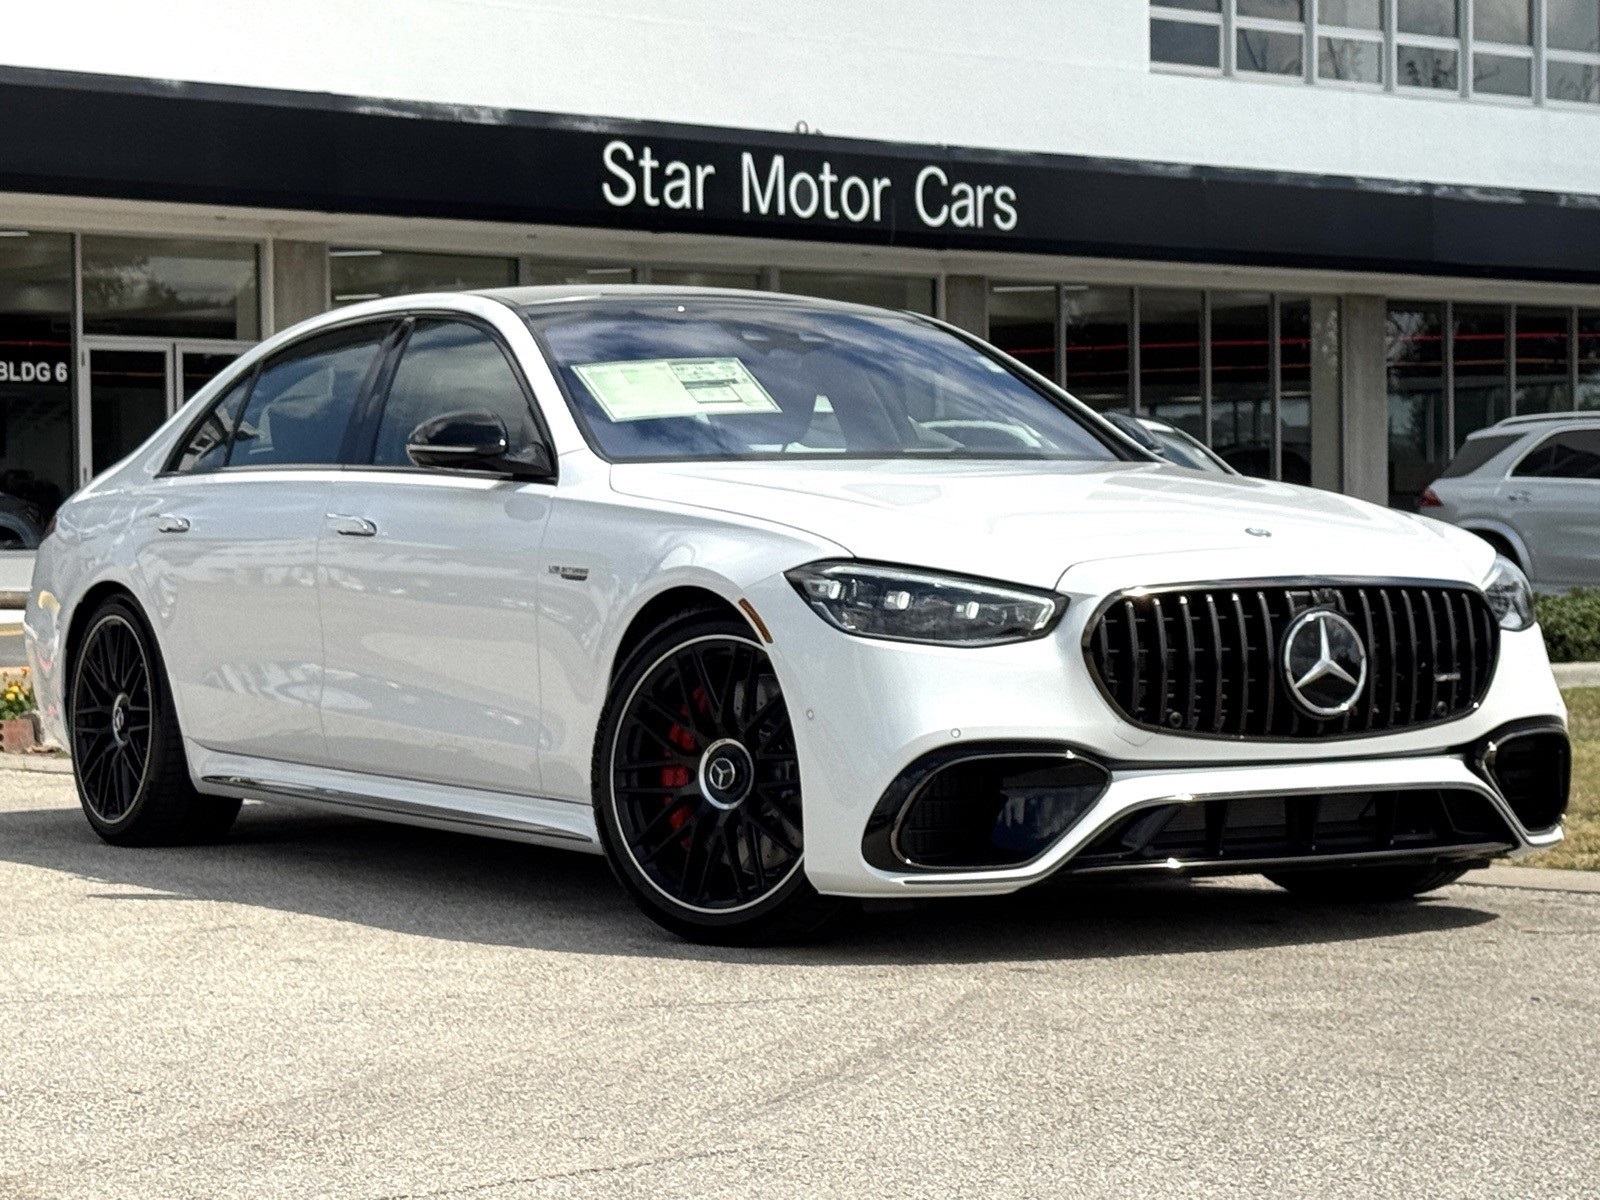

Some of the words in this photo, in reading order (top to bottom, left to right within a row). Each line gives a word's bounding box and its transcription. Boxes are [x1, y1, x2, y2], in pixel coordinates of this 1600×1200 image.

[602, 140, 716, 210] Star
[741, 151, 891, 222] Motor
[915, 165, 1018, 231] Cars
[0, 361, 51, 382] BLDG
[55, 361, 68, 382] 6
